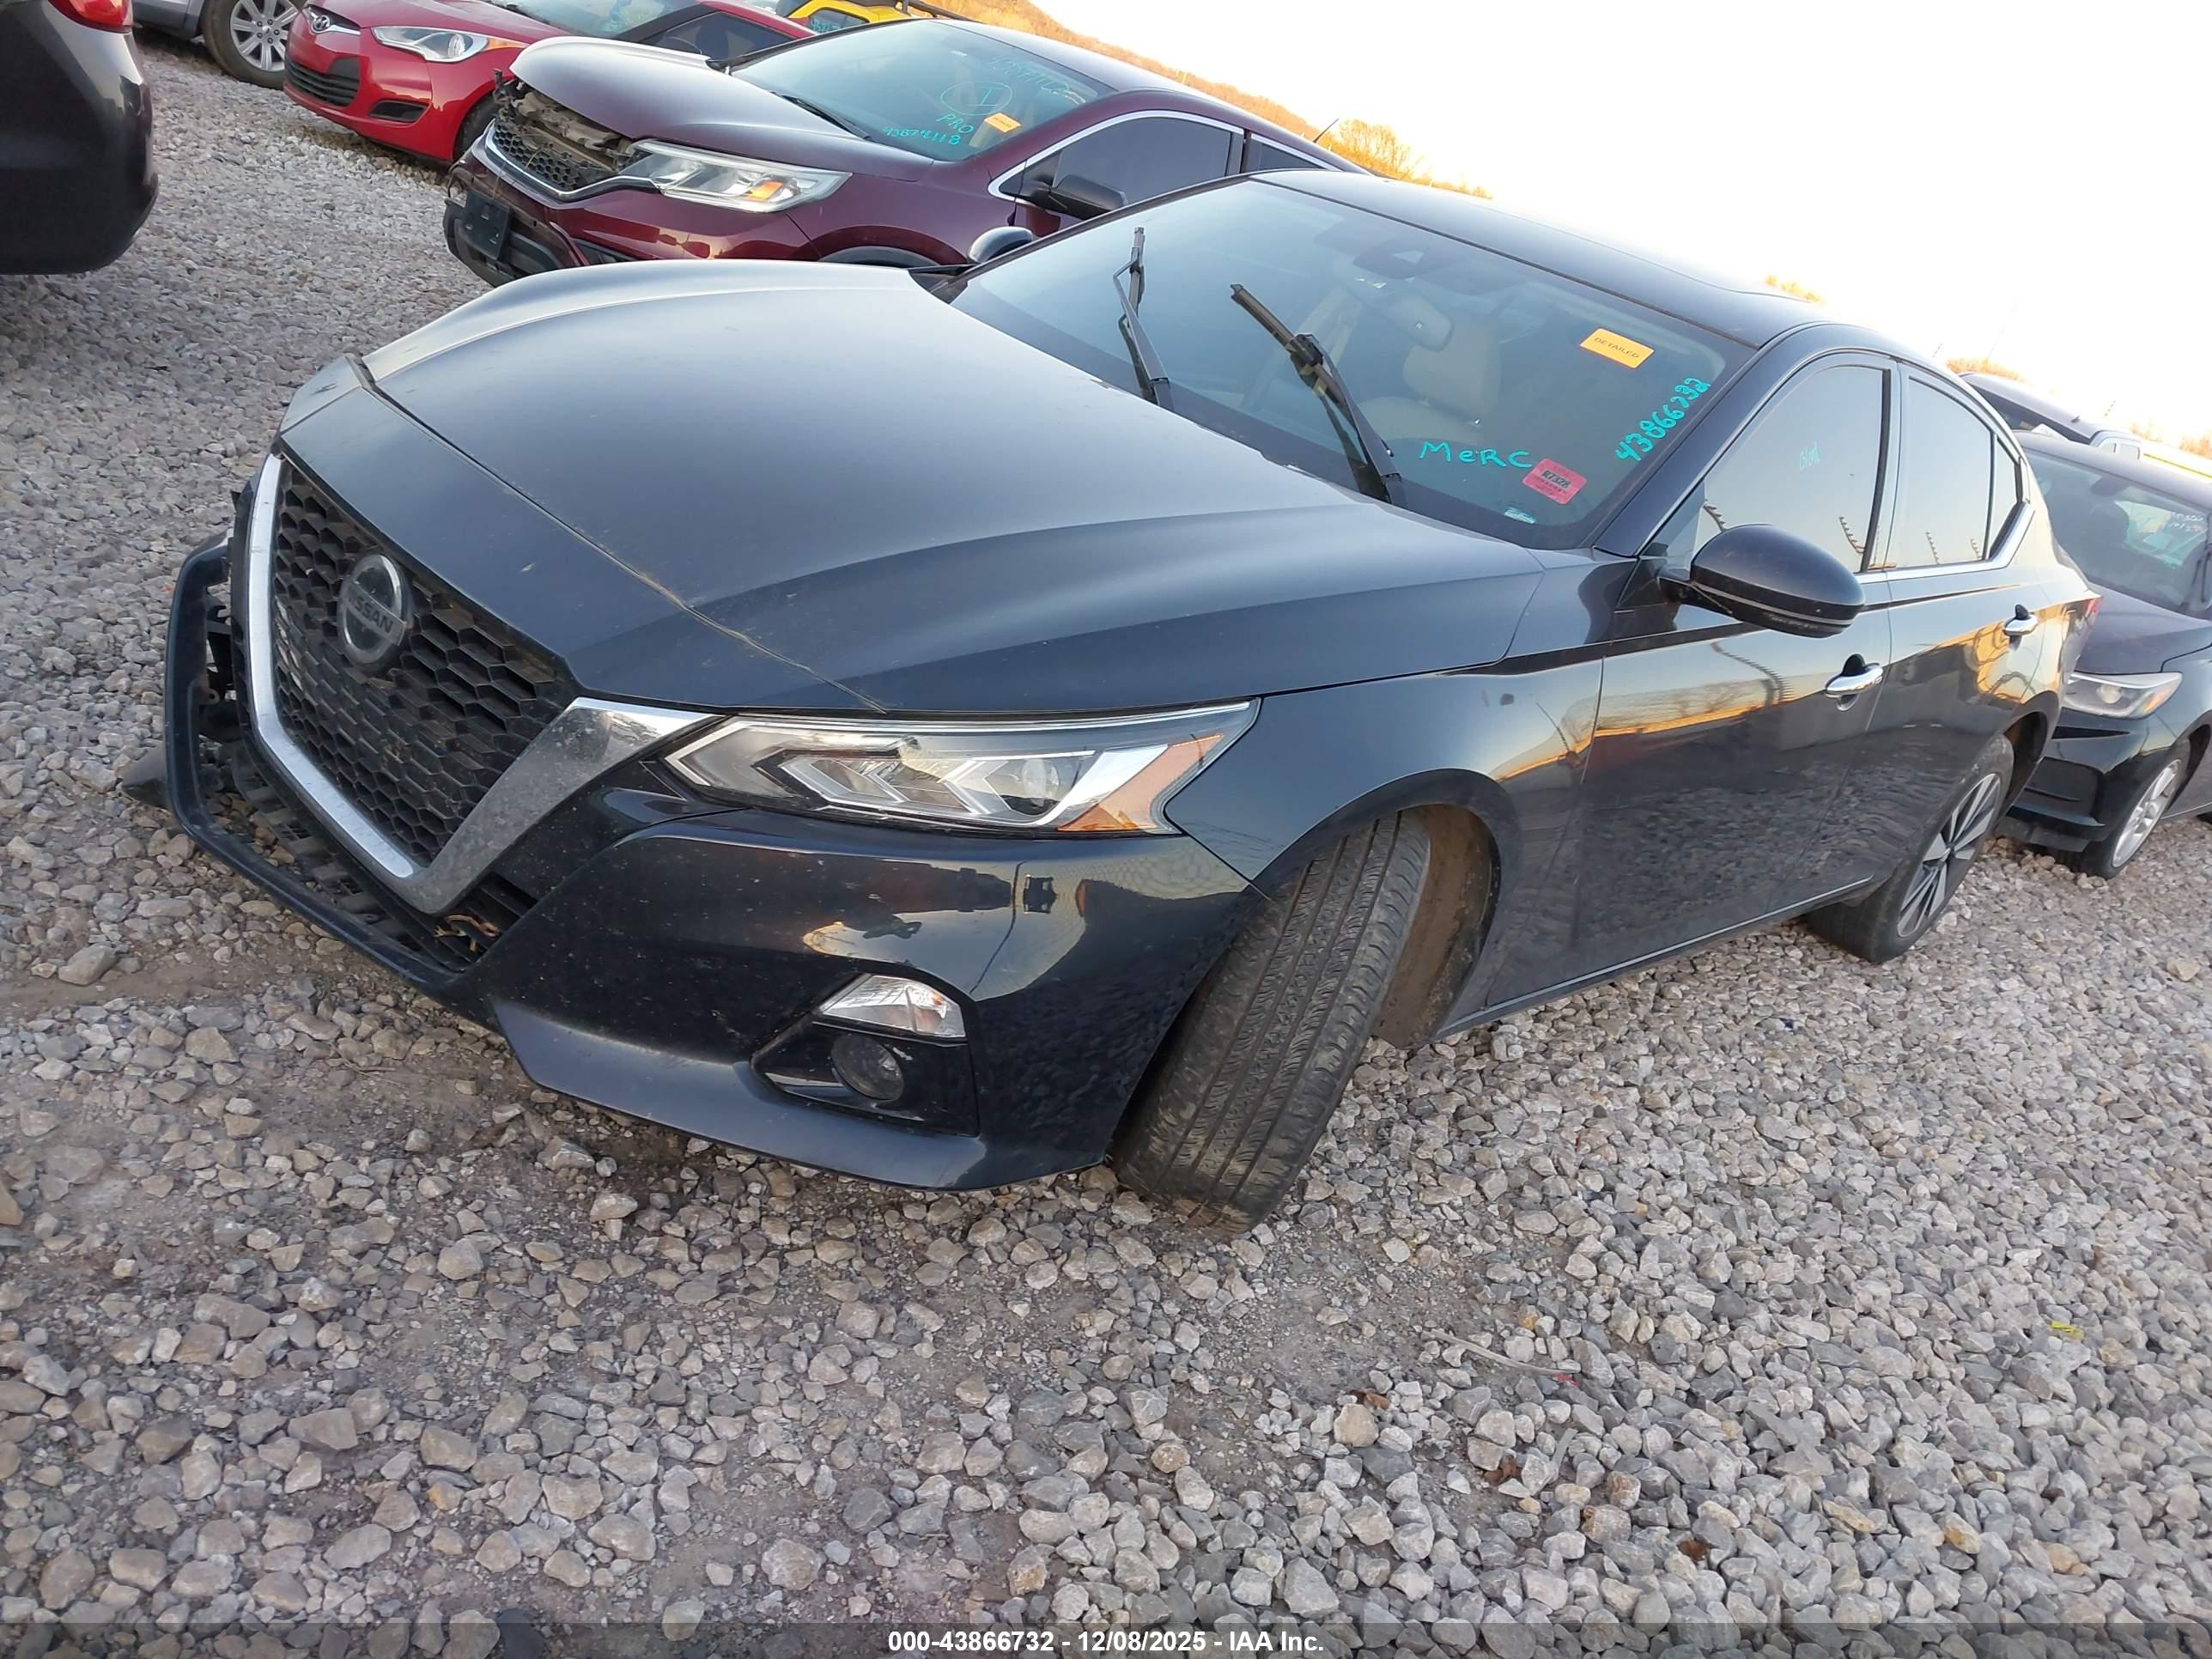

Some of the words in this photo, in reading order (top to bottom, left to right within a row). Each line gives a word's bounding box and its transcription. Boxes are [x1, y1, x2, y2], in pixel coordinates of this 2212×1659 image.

[935, 113, 974, 134] PRO
[1594, 337, 1639, 358] DETAILED
[1615, 377, 1711, 461] 43866732
